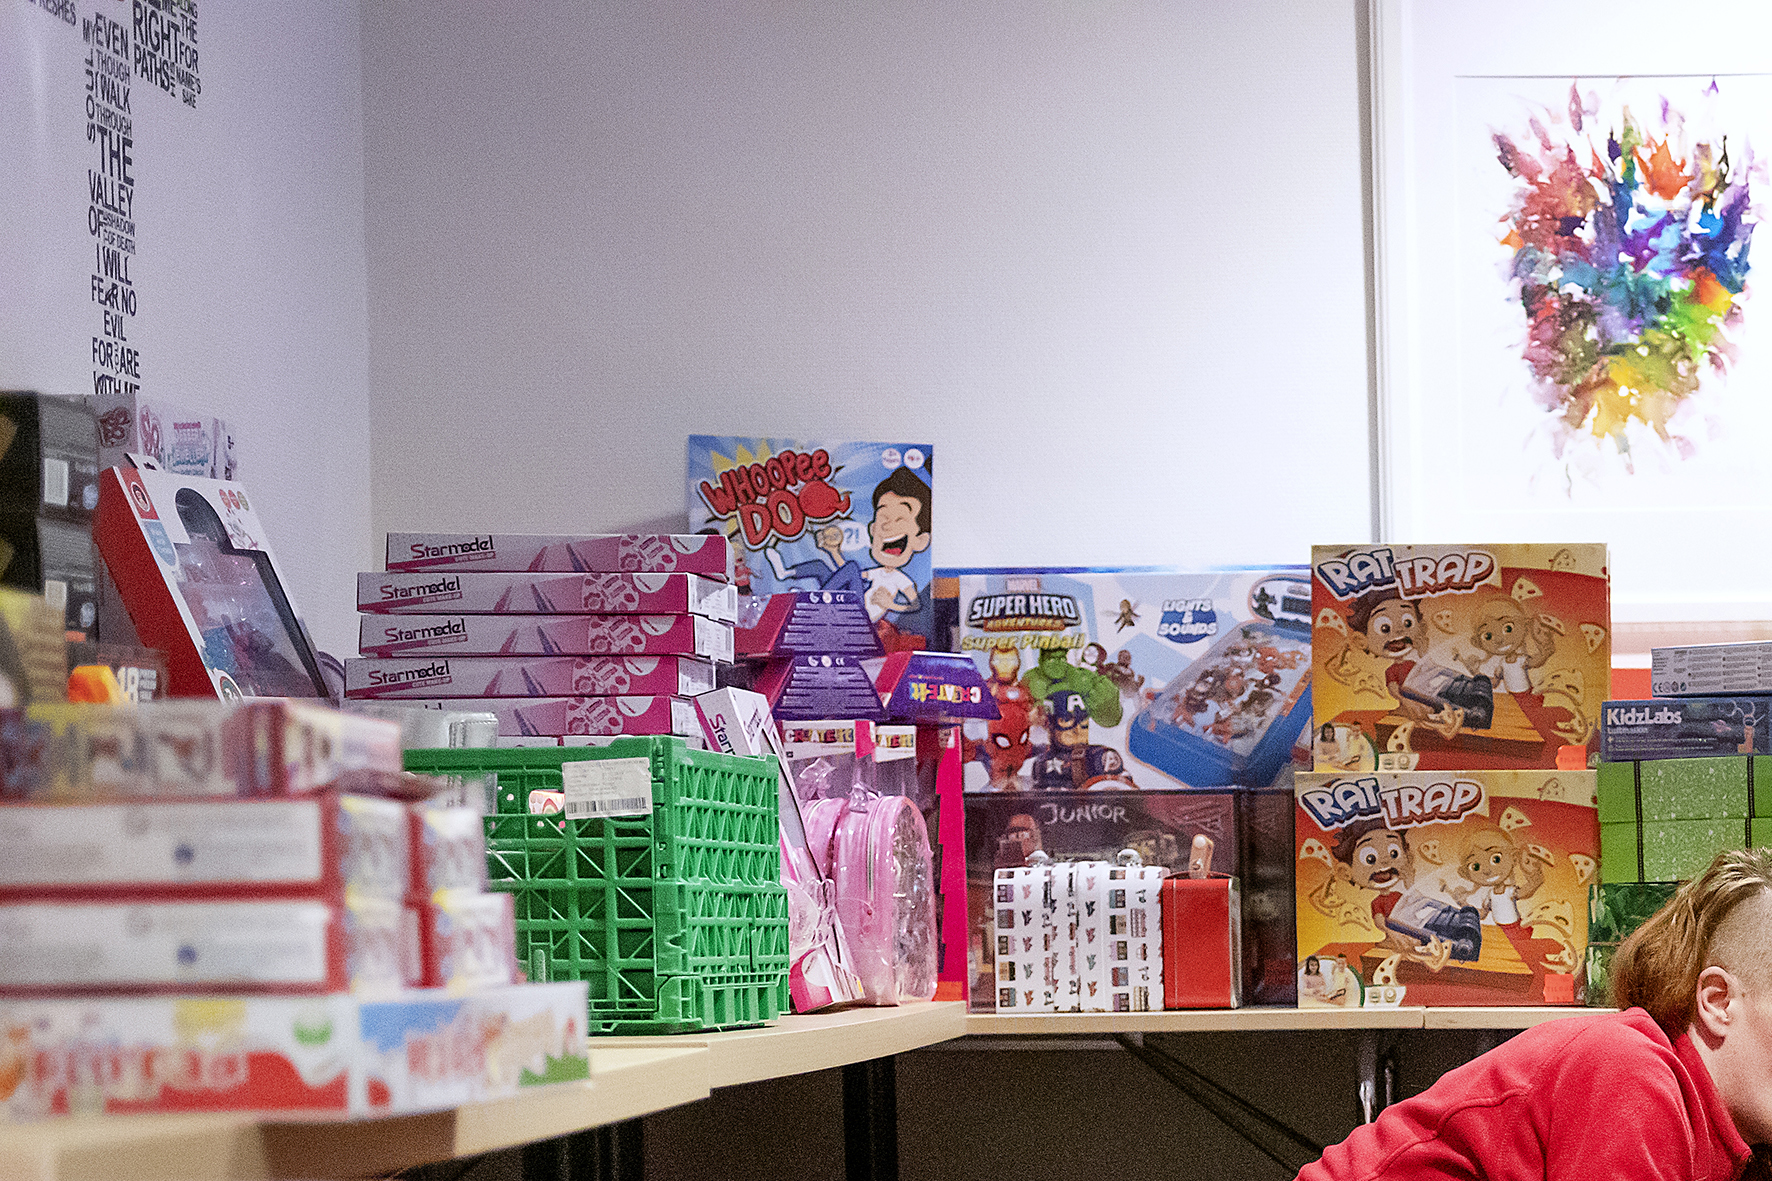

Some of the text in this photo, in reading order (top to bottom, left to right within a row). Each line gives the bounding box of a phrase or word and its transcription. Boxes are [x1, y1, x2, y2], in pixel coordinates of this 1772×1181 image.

[95, 12, 129, 60] EVEN
[133, 1, 198, 63] RIGHT THE
[96, 49, 131, 85] THOUGH
[134, 43, 170, 91] PATHS
[179, 41, 199, 73] FOR
[85, 48, 95, 144] SOUL
[100, 73, 131, 115] WALK
[96, 103, 133, 138] THROUGH
[97, 124, 134, 187] THE
[88, 169, 134, 219] VALLEY
[88, 205, 103, 238] OF
[107, 212, 136, 238] SHADOW
[117, 235, 136, 255] DEATH
[102, 246, 132, 286] WILL
[91, 274, 137, 317] FEAR NO
[104, 310, 127, 342] EVIL
[92, 337, 113, 370] FOR
[119, 346, 141, 379] ARE
[411, 535, 494, 559] Starmodel
[380, 576, 460, 600] Starmodel
[1318, 549, 1495, 596] RAT TRAP
[971, 595, 1077, 619] SUPER HERO
[385, 618, 466, 643] Starmodel
[368, 660, 450, 686] Starmodel
[1607, 707, 1683, 725] KidzLabs
[1301, 778, 1483, 828] RAT TRAP
